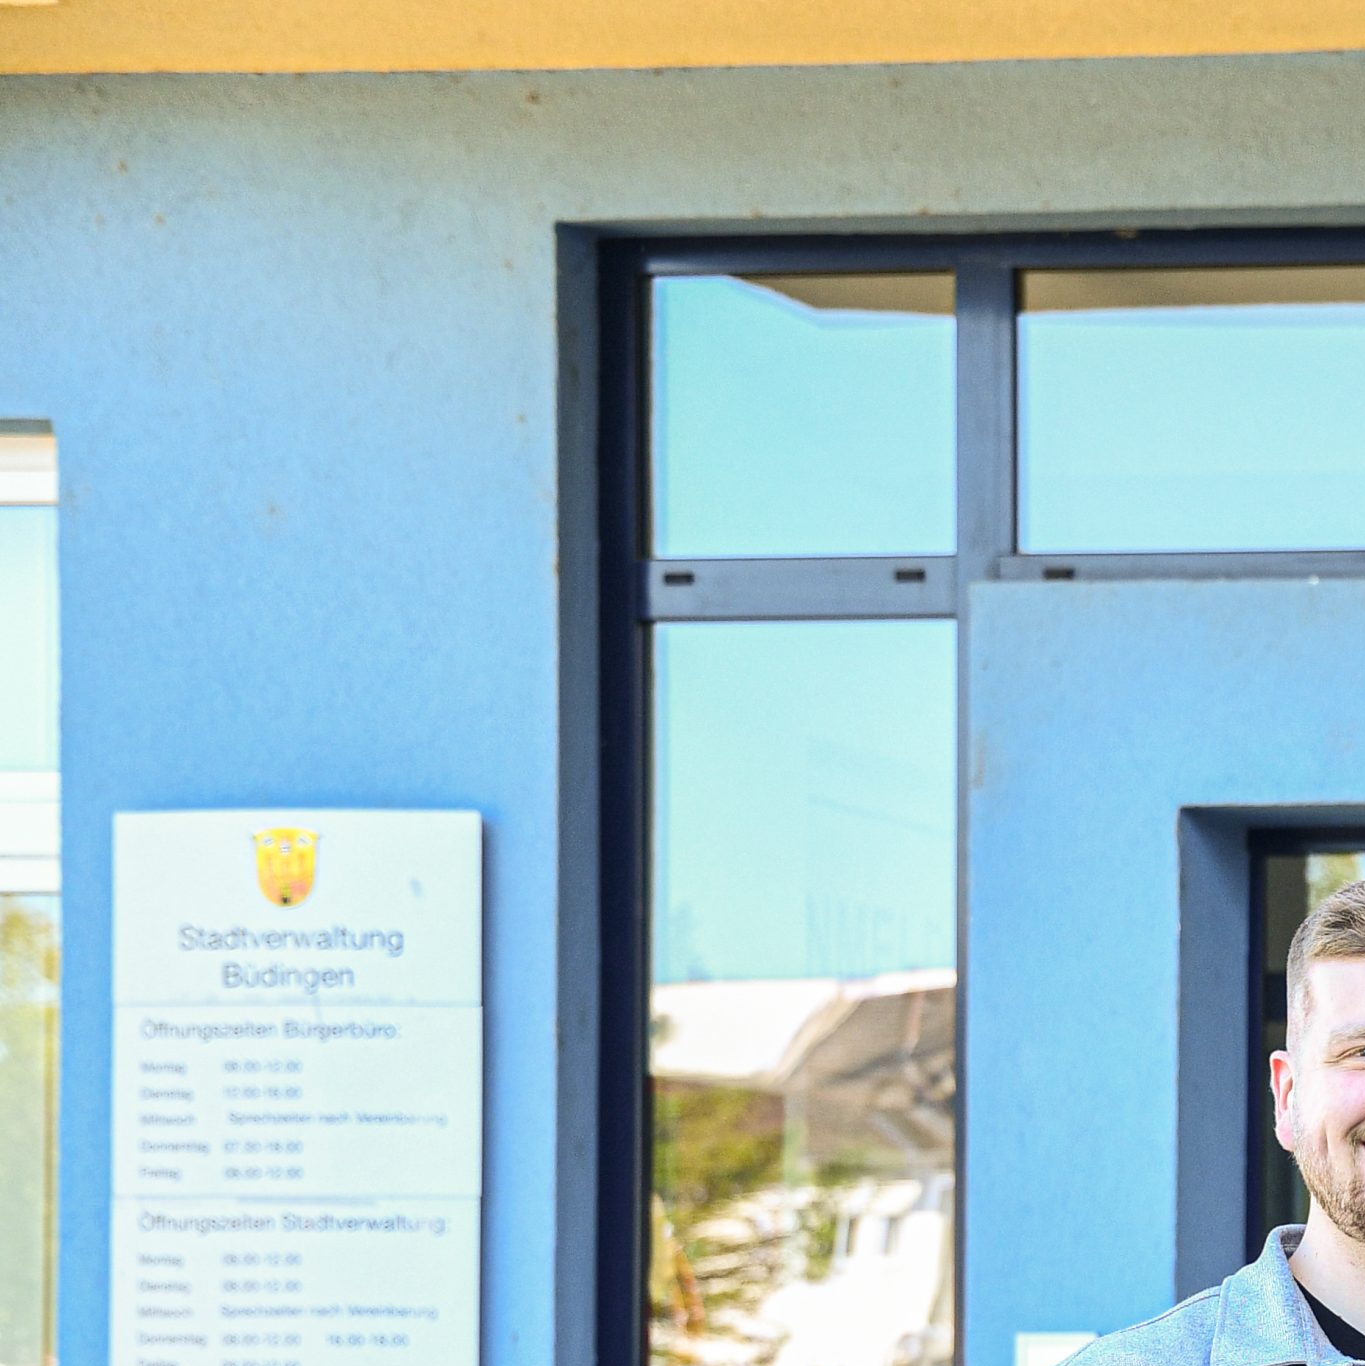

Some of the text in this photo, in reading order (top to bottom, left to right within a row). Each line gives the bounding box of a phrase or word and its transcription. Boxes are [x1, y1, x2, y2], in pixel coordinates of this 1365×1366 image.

[178, 925, 404, 957] Stadtverwaltung
[222, 961, 355, 994] Büdingen
[141, 1018, 276, 1043] Öffnungszeiten
[138, 1210, 276, 1236] Öffnungszeiten
